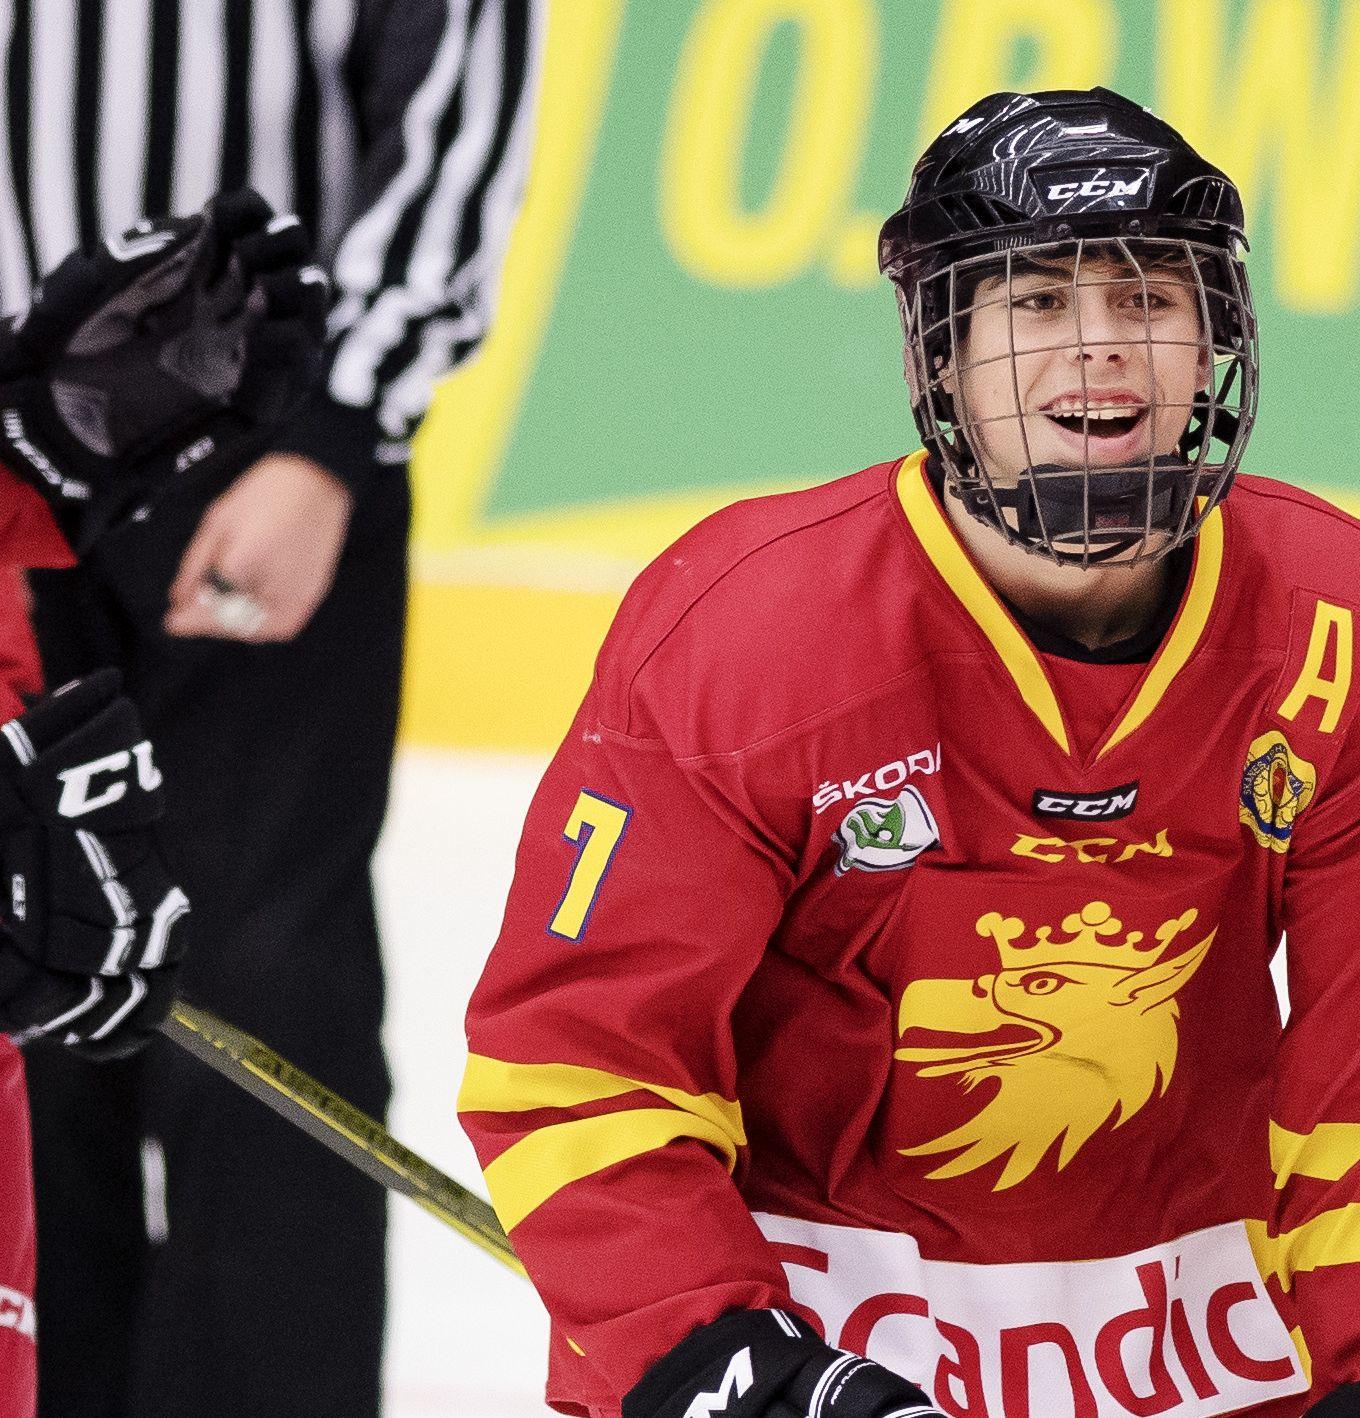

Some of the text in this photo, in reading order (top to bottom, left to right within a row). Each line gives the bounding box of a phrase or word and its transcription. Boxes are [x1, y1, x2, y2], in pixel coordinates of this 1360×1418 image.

[1047, 180, 1143, 201] CCM
[1276, 599, 1353, 734] A
[1037, 789, 1138, 816] CCM
[546, 787, 633, 943] 7
